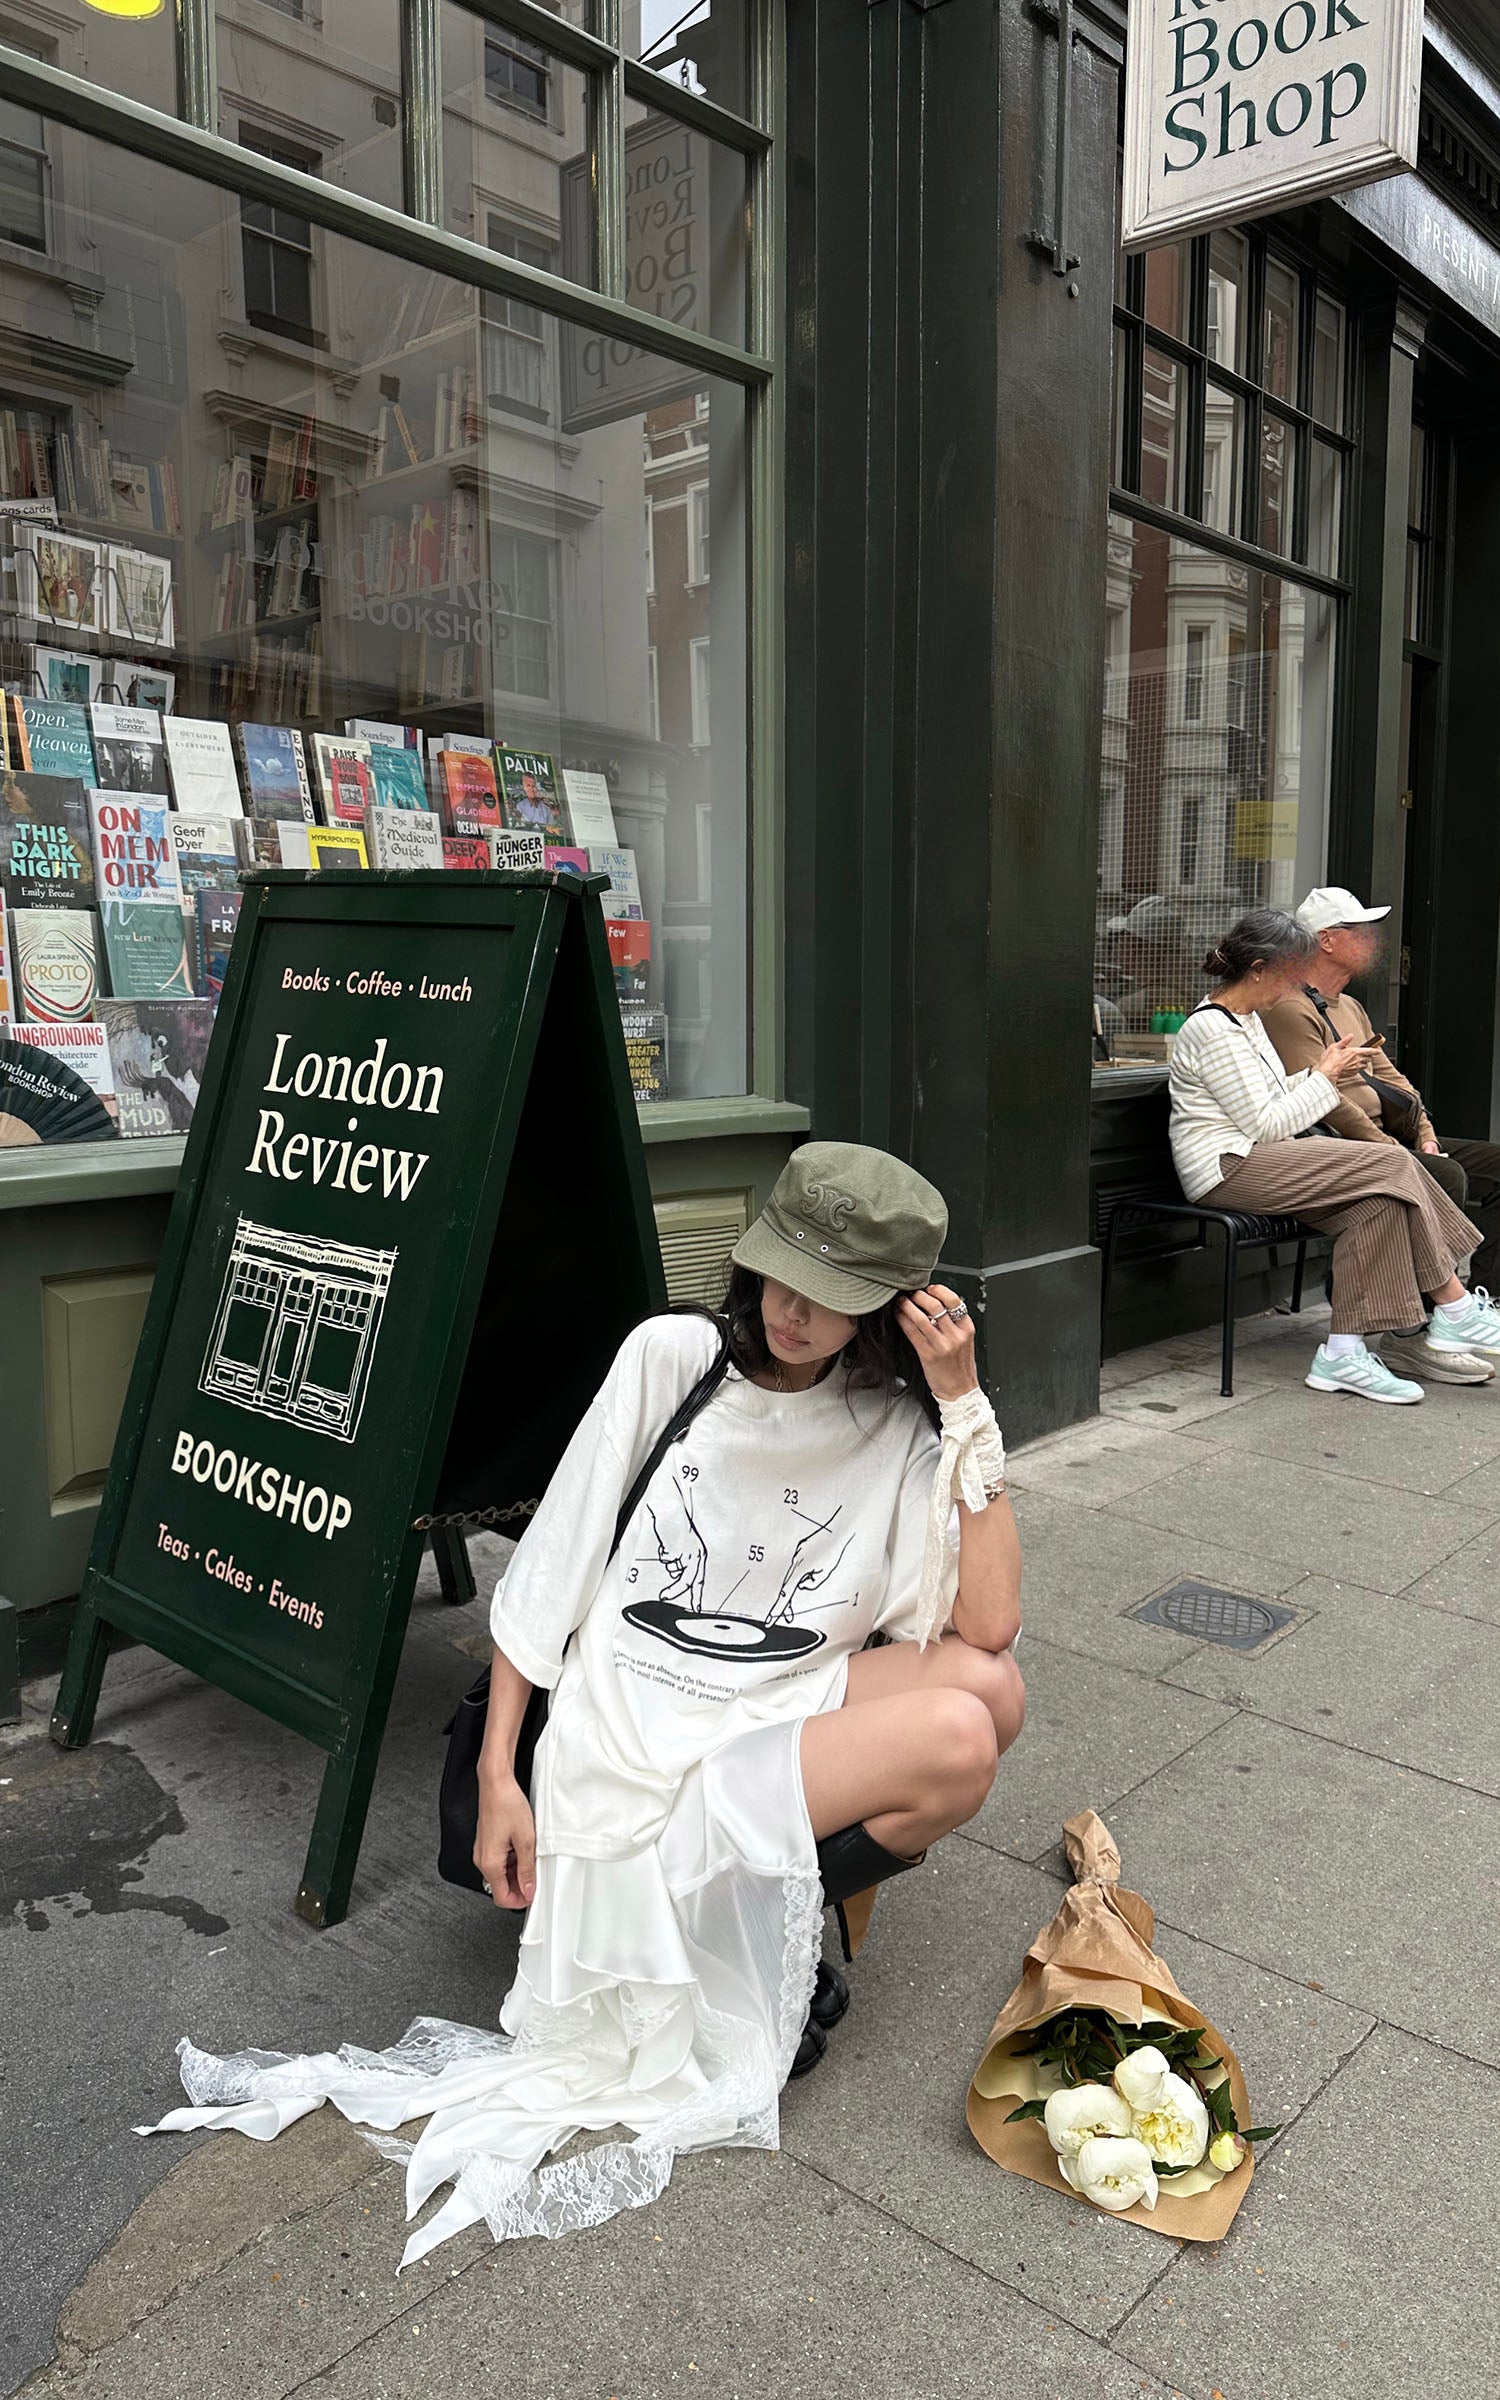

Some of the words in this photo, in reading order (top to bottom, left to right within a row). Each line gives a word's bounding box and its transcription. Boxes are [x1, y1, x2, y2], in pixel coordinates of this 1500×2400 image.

[1166, 0, 1369, 98] Book
[1163, 62, 1368, 177] Shop
[1423, 212, 1489, 292] PRESENT
[23, 504, 52, 515] cards
[348, 592, 511, 651] BOOKSHOP
[180, 730, 218, 741] OUTSIDER
[360, 729, 396, 744] Soundings
[175, 741, 226, 752] EVERYWHERE
[333, 748, 358, 762] RAISE
[336, 761, 359, 774] YOUR
[504, 756, 550, 777] PALIN
[292, 733, 314, 820] ENDLING
[339, 773, 361, 786] SOUL
[455, 783, 492, 794] EMPEROR
[98, 805, 142, 833] ON
[455, 806, 497, 818] GLADNESS
[390, 815, 408, 828] The
[456, 821, 480, 835] OCEAN
[15, 823, 69, 844] THIS
[173, 824, 206, 838] Geoff
[311, 833, 361, 845] HYPERPOLITICS
[386, 828, 438, 845] Medieval
[12, 841, 78, 862] DARK
[100, 834, 170, 862] MEM
[174, 837, 203, 851] Dyer
[390, 842, 425, 858] Guide
[441, 839, 477, 857] DEEP
[496, 836, 543, 855] HUNGER
[507, 850, 543, 868] THIRST
[547, 851, 563, 861] The
[602, 852, 610, 865] If
[611, 853, 627, 866] We
[9, 858, 82, 880] NIGHT
[104, 862, 160, 889] OIR
[21, 887, 46, 899] Emily
[221, 905, 236, 915] LA
[113, 933, 131, 941] NEW
[132, 930, 152, 943] LEFT
[608, 926, 627, 938] Few
[28, 964, 89, 981] PROTO
[281, 967, 331, 992] Books
[346, 970, 403, 998] Coffee
[419, 975, 472, 1002] Lunch
[633, 978, 647, 990] Far
[618, 996, 646, 1005] tween
[620, 1016, 654, 1028] NDON'S
[12, 1026, 104, 1047] UNGROUNDING
[53, 1050, 99, 1061] rchitecture
[626, 1045, 660, 1057] GREATER
[628, 1057, 652, 1067] NDON
[0, 1060, 36, 1083] ondon
[36, 1074, 82, 1102] Review
[262, 1033, 444, 1114] London
[630, 1068, 653, 1079] UNCIL
[8, 1075, 54, 1099] BOOKSHOP
[115, 1092, 142, 1107] THE
[119, 1107, 167, 1130] MUD
[244, 1108, 430, 1202] Review
[681, 1465, 700, 1483] 99
[171, 1430, 352, 1541] BOOKSHOP
[783, 1488, 799, 1505] 23
[748, 1545, 765, 1562] 55
[157, 1522, 190, 1561] Teas
[205, 1548, 253, 1593] Cakes
[268, 1579, 324, 1631] Events
[626, 1567, 640, 1584] 3
[636, 1659, 647, 1668] not
[656, 1665, 682, 1681] absence.
[683, 1675, 695, 1685] On
[695, 1678, 707, 1688] the
[636, 1670, 651, 1680] most
[652, 1673, 676, 1689] intense
[676, 1684, 686, 1693] of
[686, 1687, 697, 1697] all
[697, 1691, 730, 1704] presence
